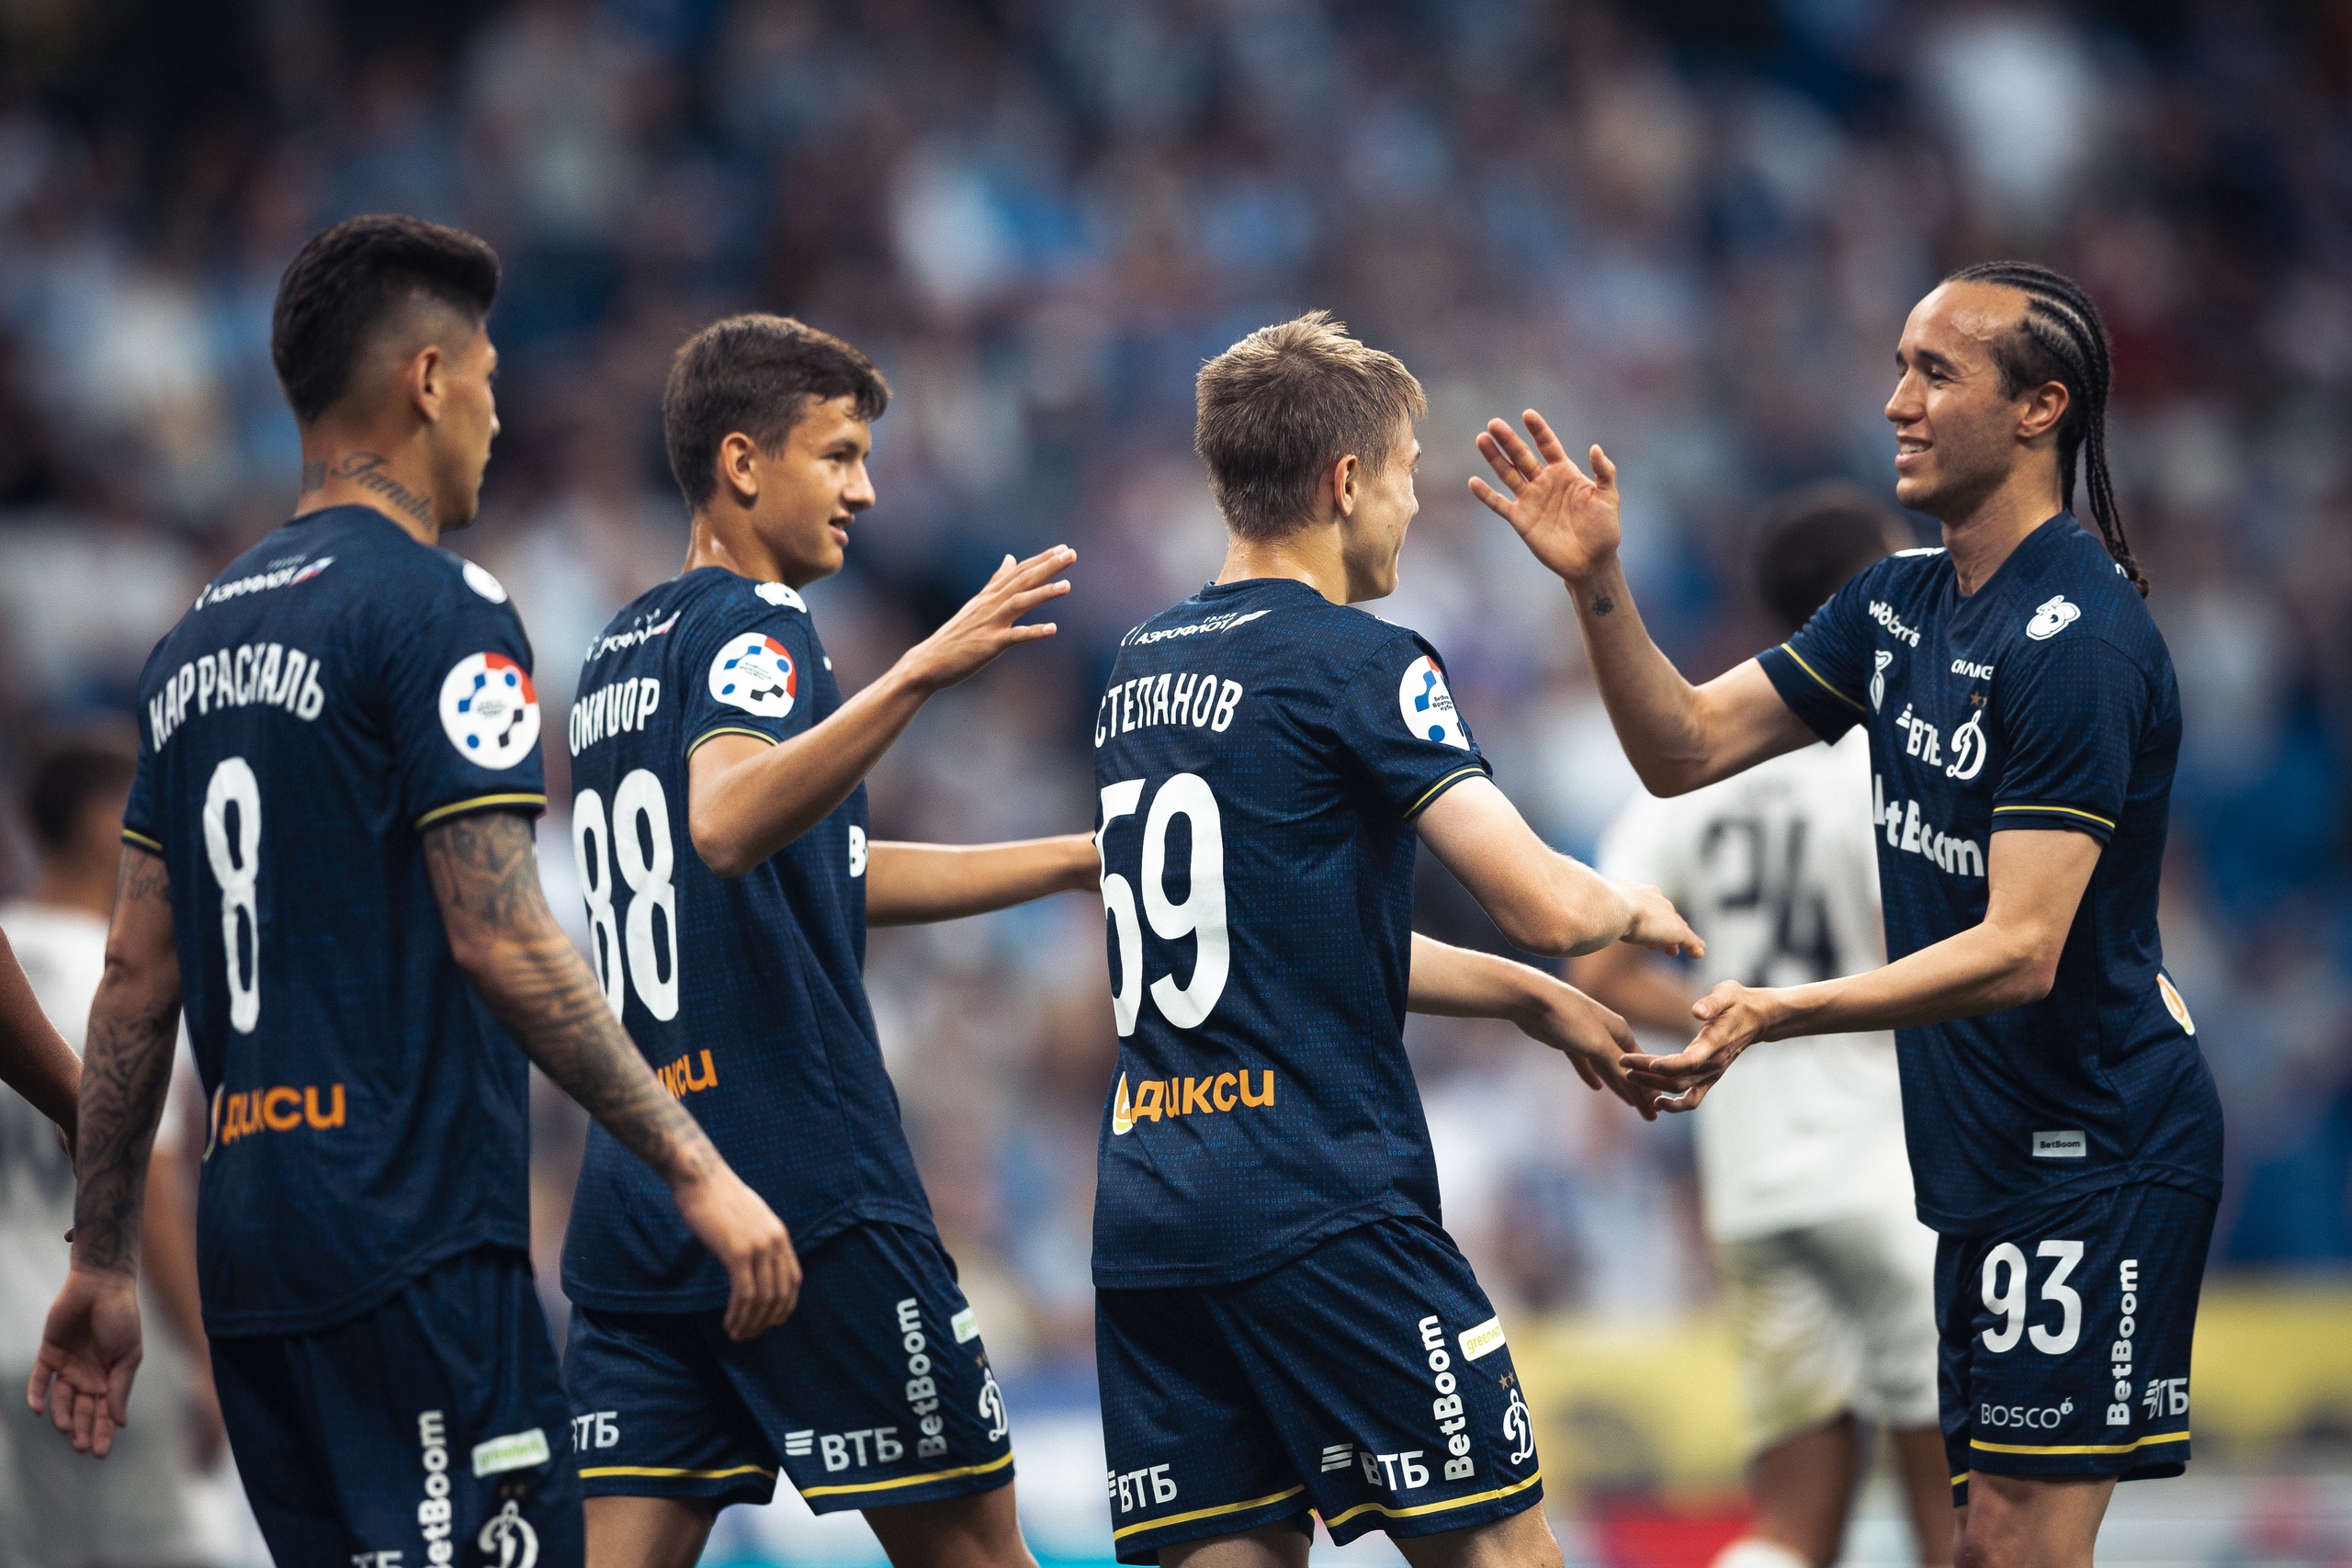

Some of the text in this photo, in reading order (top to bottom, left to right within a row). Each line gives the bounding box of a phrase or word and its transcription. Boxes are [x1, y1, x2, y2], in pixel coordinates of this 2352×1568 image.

[1135, 616, 1234, 645] АЭРОФЛОТ
[1095, 672, 1243, 749] СТЕПАНОВ
[203, 756, 261, 1034] 8
[572, 768, 679, 1022] 88
[1092, 773, 1230, 1037] 59
[2040, 1140, 2081, 1149] BetBoom
[1982, 1240, 2085, 1355] 93
[2106, 1258, 2139, 1426] BetBoom
[896, 1297, 947, 1458] BetBoom
[1419, 1314, 1475, 1481] BetBoom
[1981, 1403, 2061, 1428] BOSCO
[418, 1409, 454, 1568] etBoom
[820, 1426, 904, 1472] ВТБ
[1117, 1462, 1178, 1514] ВТБ
[1360, 1450, 1430, 1491] ВТБ
